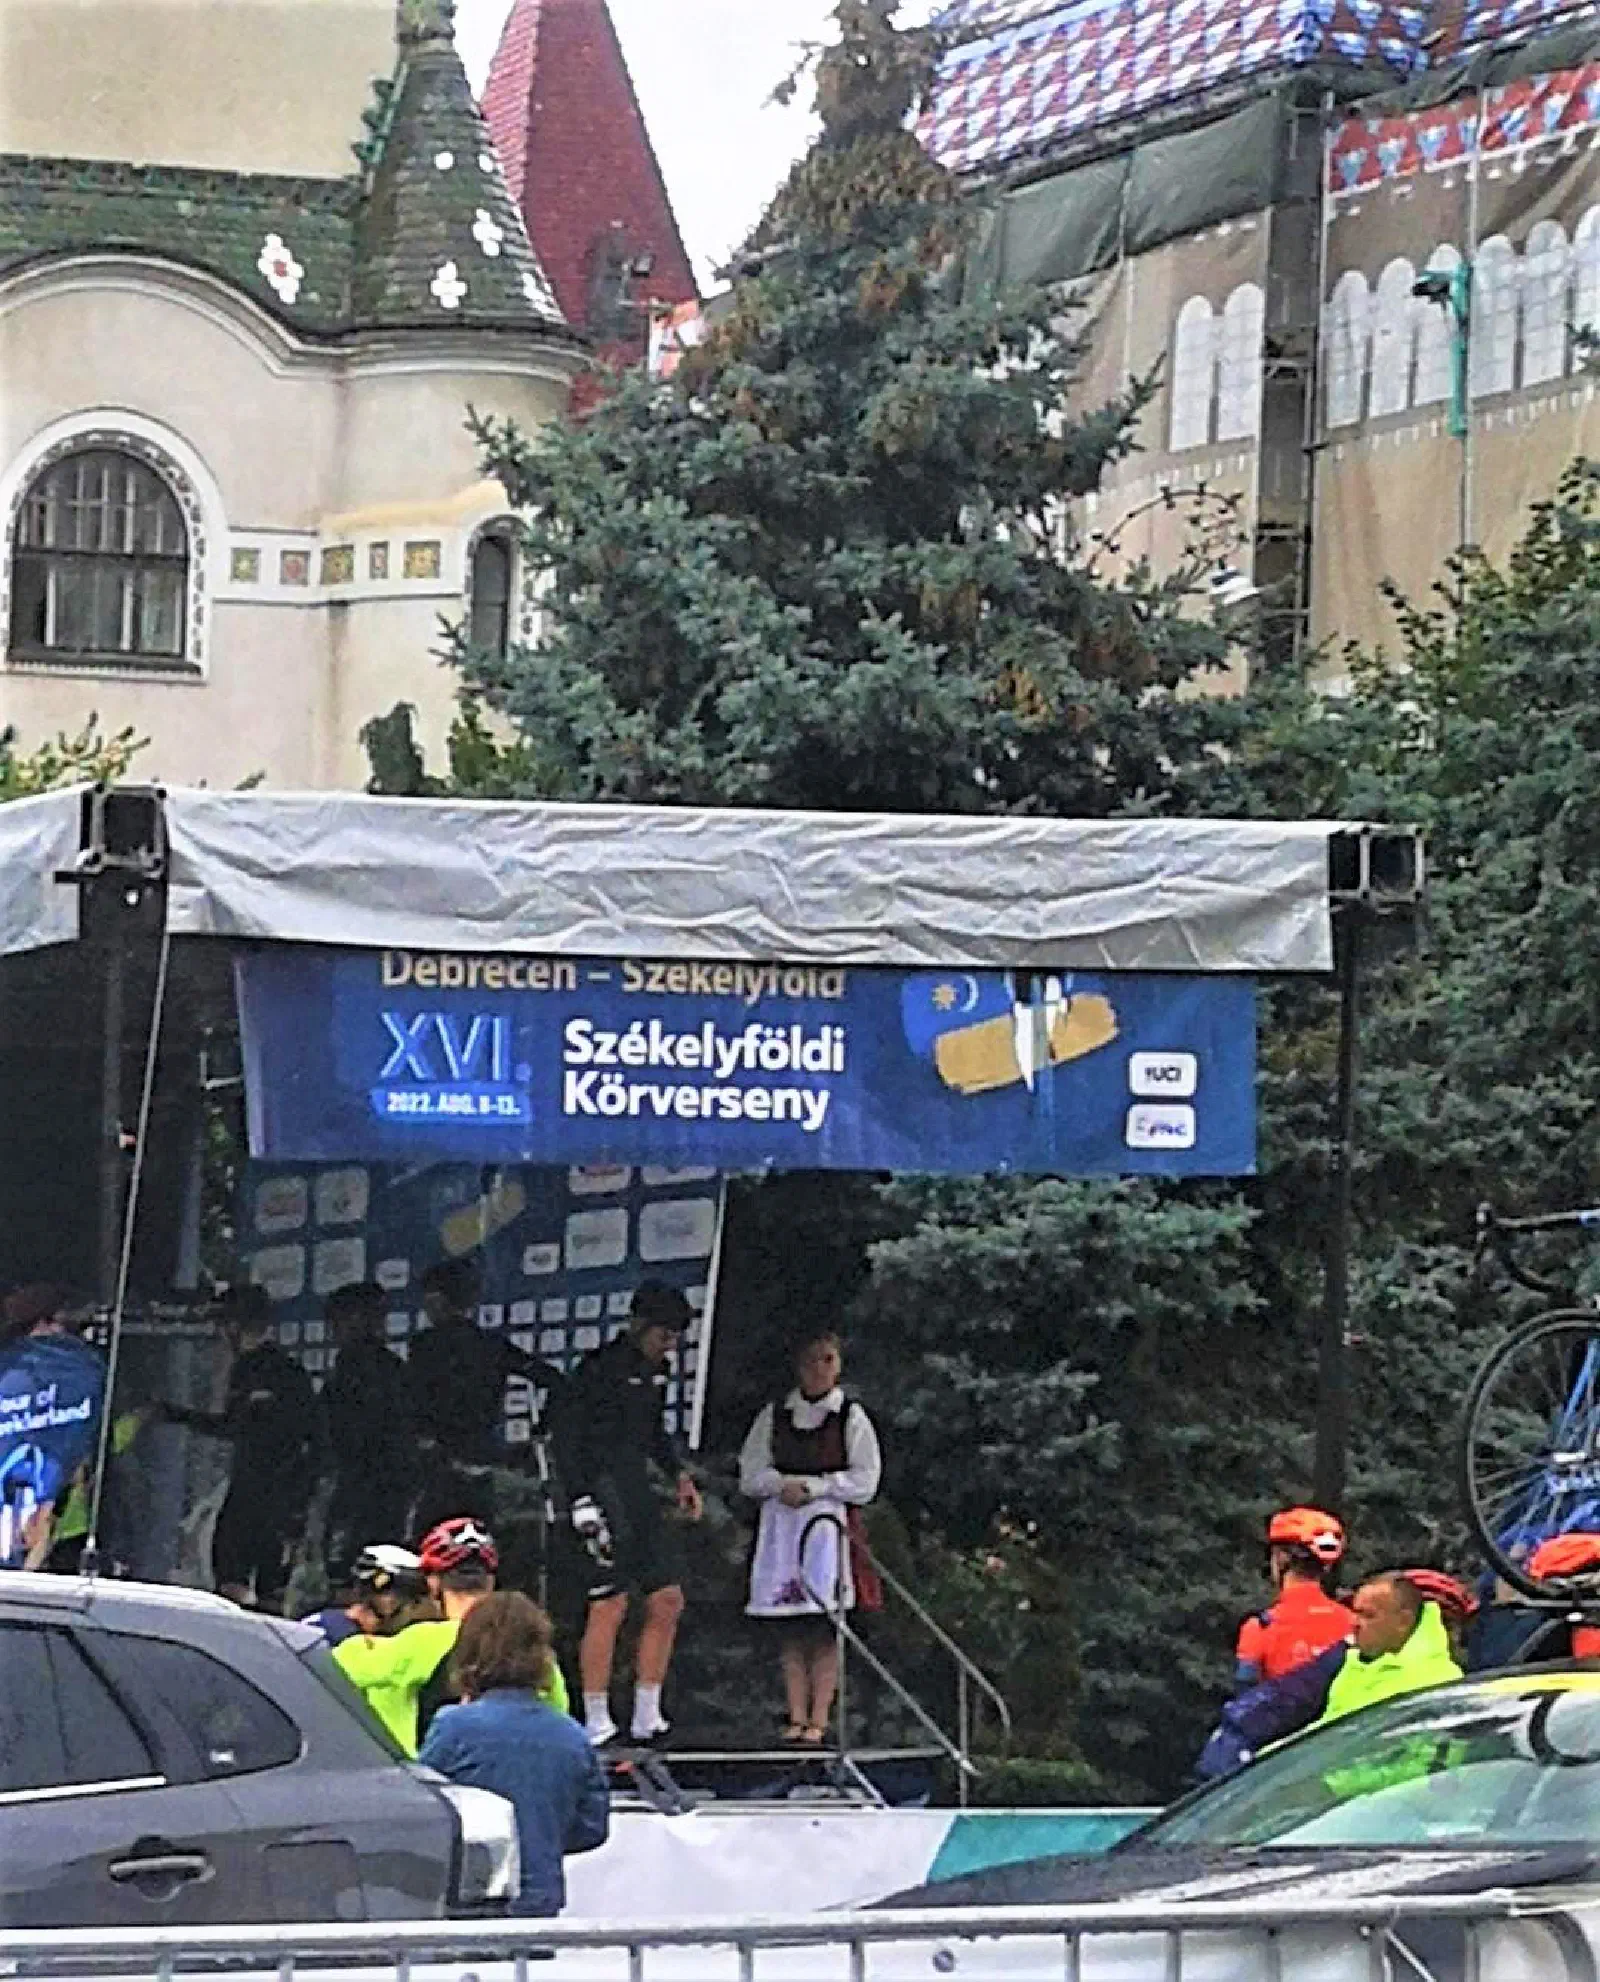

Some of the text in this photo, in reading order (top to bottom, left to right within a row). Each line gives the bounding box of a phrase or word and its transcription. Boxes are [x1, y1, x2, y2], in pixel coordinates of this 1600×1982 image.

[381, 951, 577, 991] Debrecen
[562, 1018, 845, 1080] Székelyföldi
[562, 1071, 831, 1132] Körverseny
